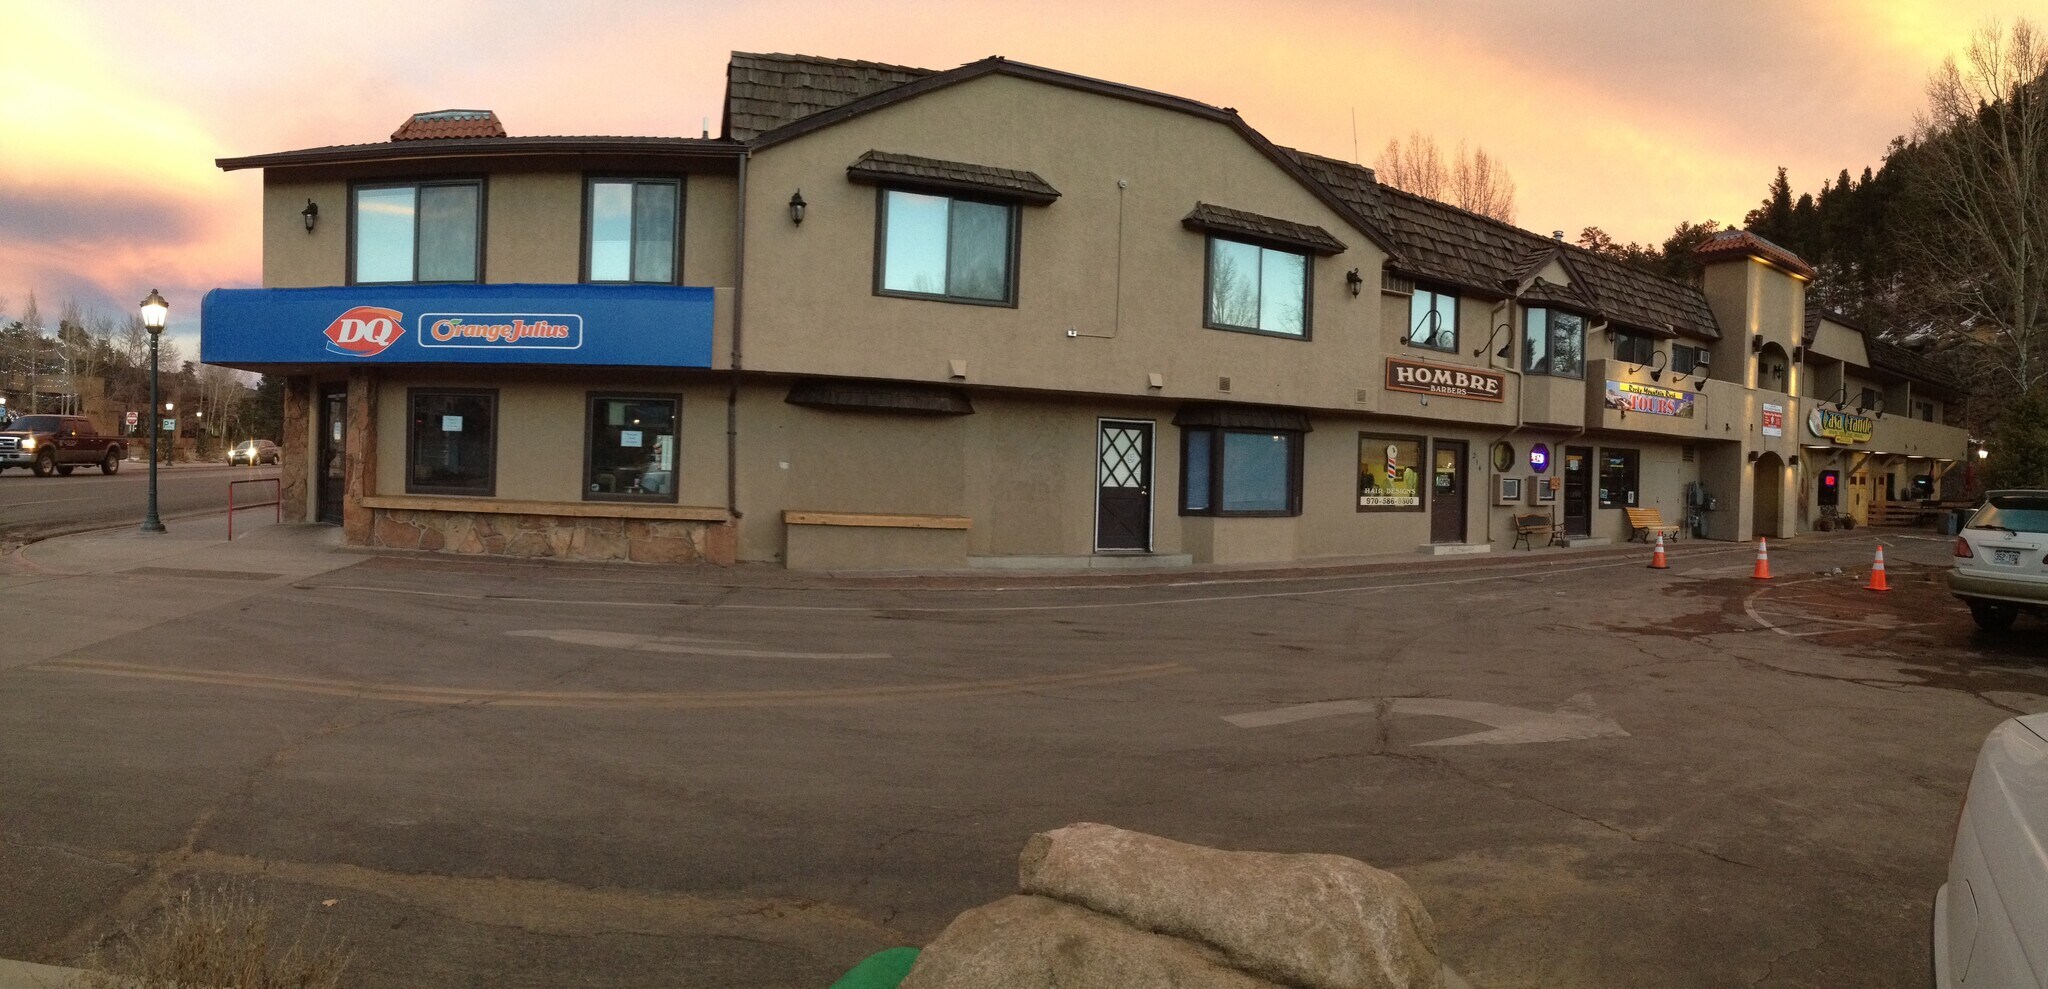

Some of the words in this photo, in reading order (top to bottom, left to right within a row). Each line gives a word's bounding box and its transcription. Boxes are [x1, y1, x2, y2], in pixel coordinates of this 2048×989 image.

[337, 318, 393, 346] DQ
[1397, 367, 1499, 393] HOMBRE
[1430, 385, 1467, 395] BARBERS
[1629, 393, 1676, 415] TOURS
[1821, 409, 1842, 430] Casa
[1843, 413, 1872, 435] Grande
[1364, 487, 1383, 495] HAIR
